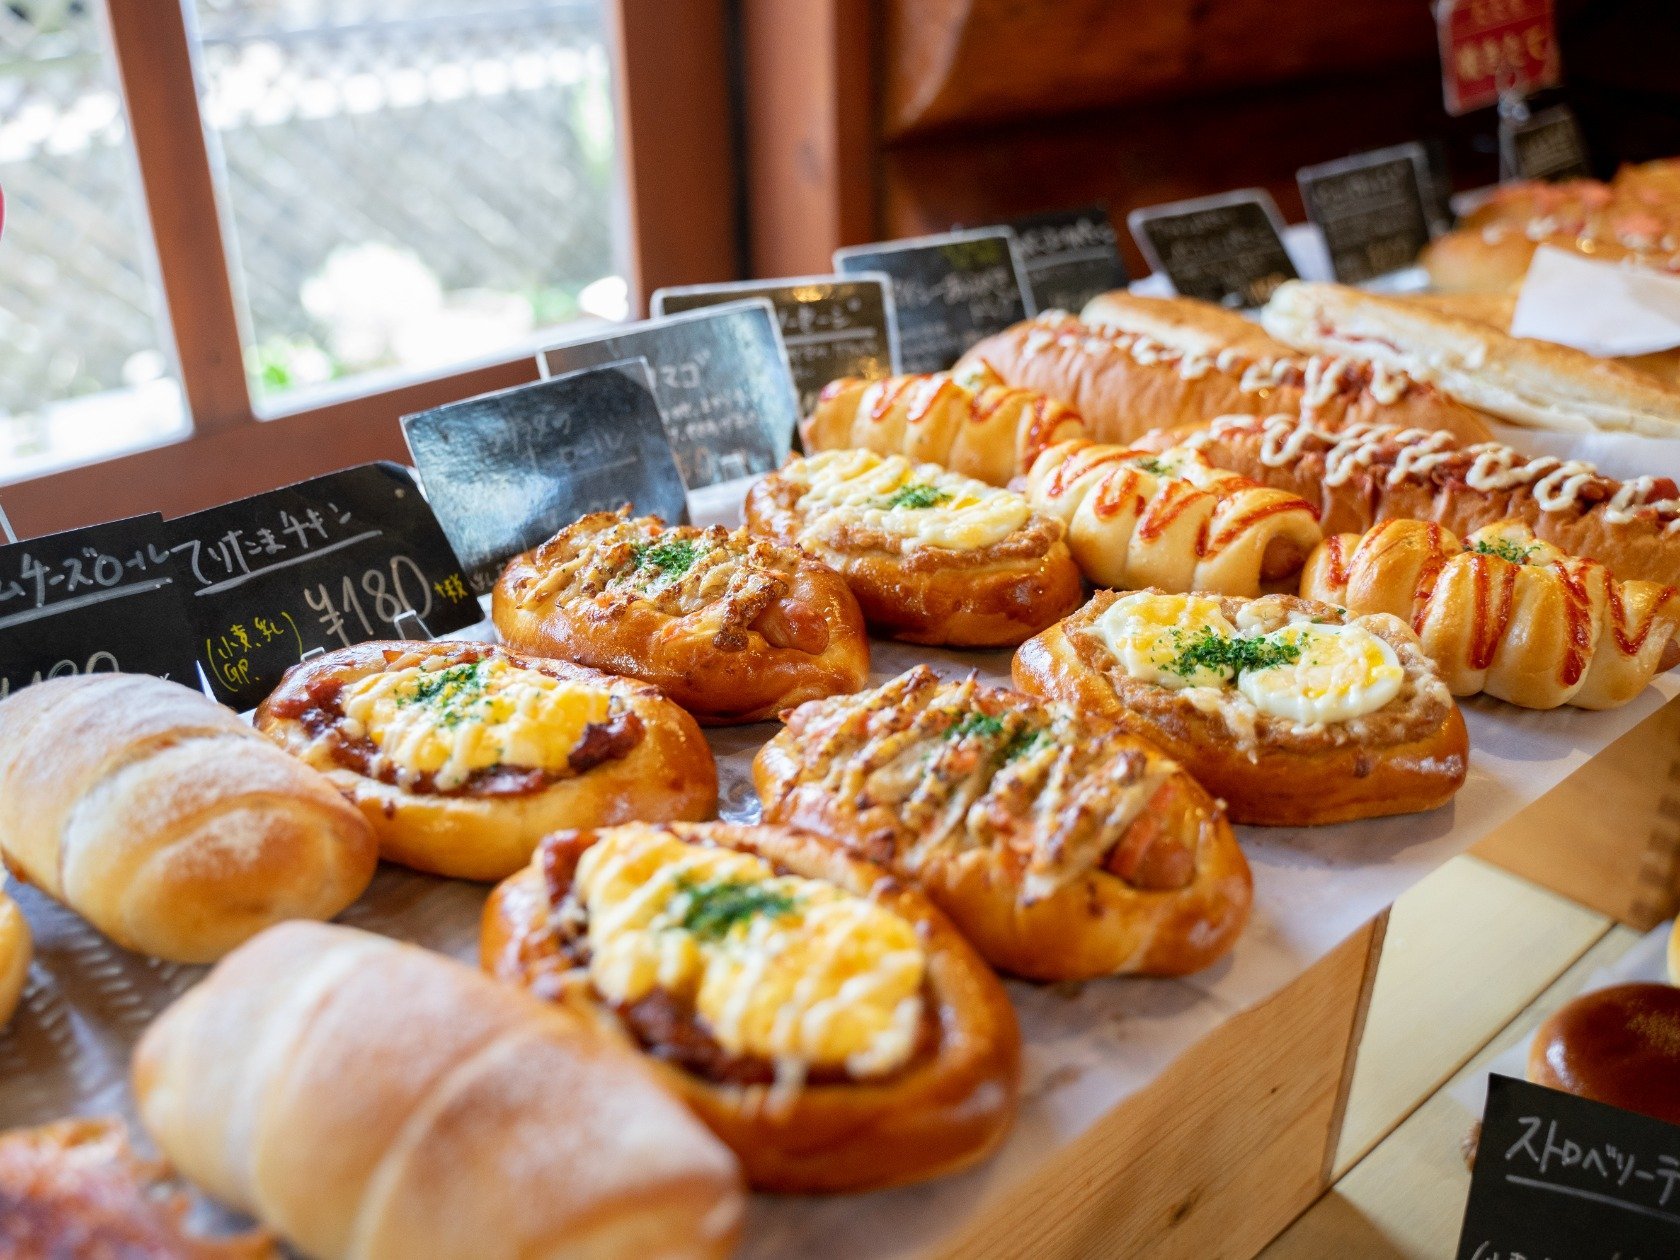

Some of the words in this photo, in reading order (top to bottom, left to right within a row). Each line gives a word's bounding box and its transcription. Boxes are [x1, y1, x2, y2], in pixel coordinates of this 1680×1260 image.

[171, 502, 351, 585] てりたまチキン
